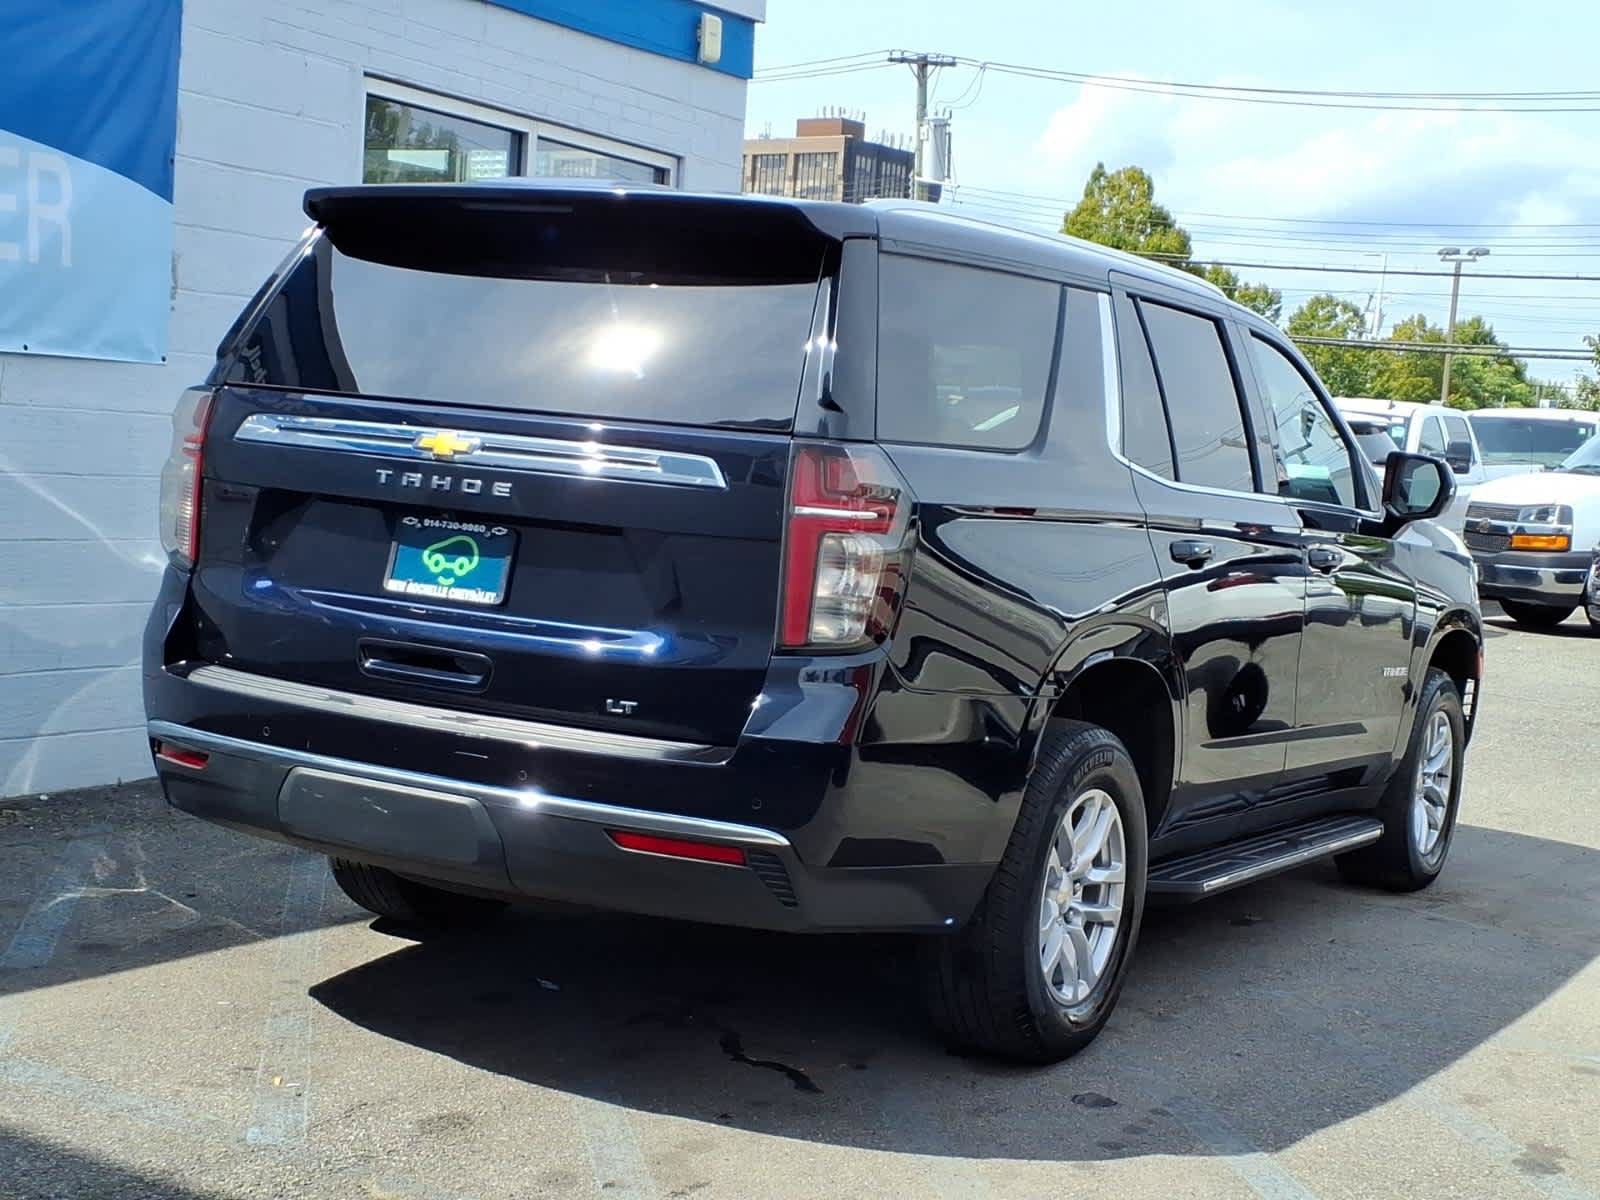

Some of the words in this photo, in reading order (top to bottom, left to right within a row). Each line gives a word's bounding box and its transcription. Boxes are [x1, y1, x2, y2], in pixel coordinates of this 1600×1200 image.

[375, 468, 513, 497] TAHOE
[606, 698, 638, 714] LT
[1073, 751, 1113, 786] MICHELIN
